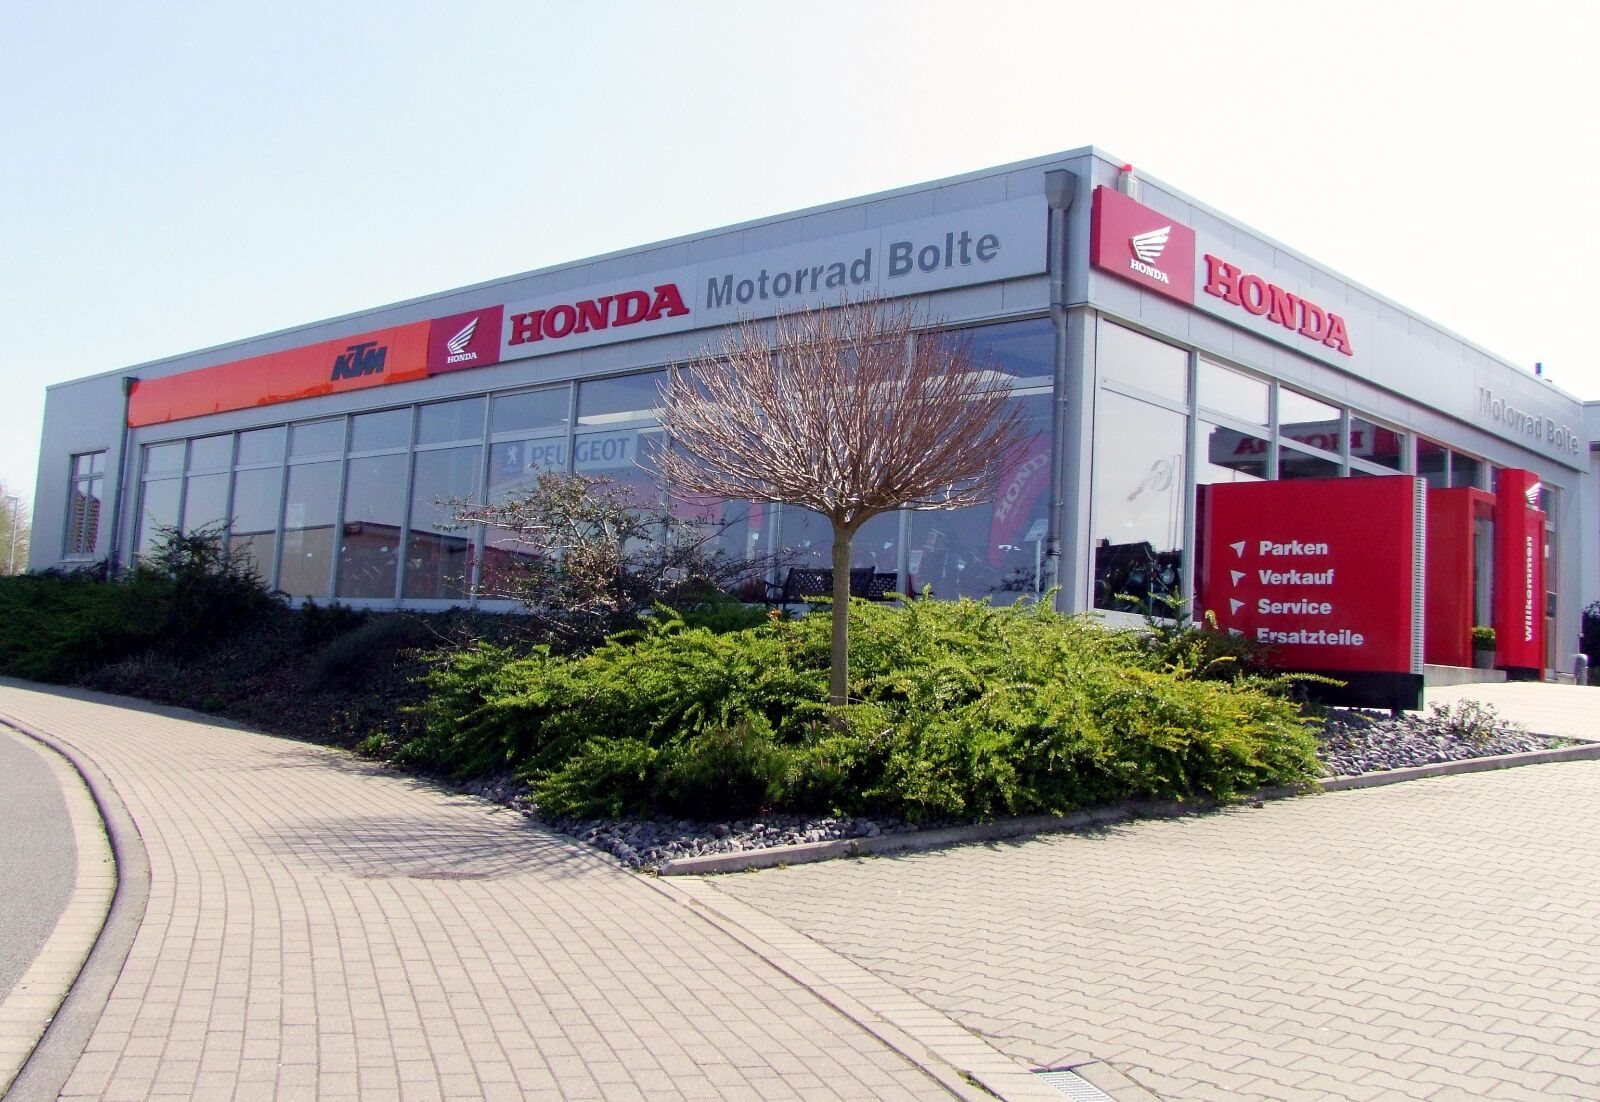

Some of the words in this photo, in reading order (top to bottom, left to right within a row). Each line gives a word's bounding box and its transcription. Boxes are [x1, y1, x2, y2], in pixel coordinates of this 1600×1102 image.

[706, 247, 872, 309] Motorrad
[888, 230, 1001, 281] Bolte
[1129, 258, 1170, 284] HONDA
[508, 283, 690, 346] HONDA
[1203, 253, 1354, 356] HONDA
[331, 341, 388, 381] KTM
[447, 351, 478, 364] HONDA
[1478, 385, 1543, 440] Motorrad
[1546, 417, 1579, 455] Bolte
[531, 437, 631, 466] PEUGEOT
[994, 453, 1050, 524] HOND
[1259, 540, 1329, 556] Parken
[1258, 568, 1335, 585] Verkauf
[1257, 598, 1332, 615] Service
[1256, 627, 1364, 646] Ersatzteile
